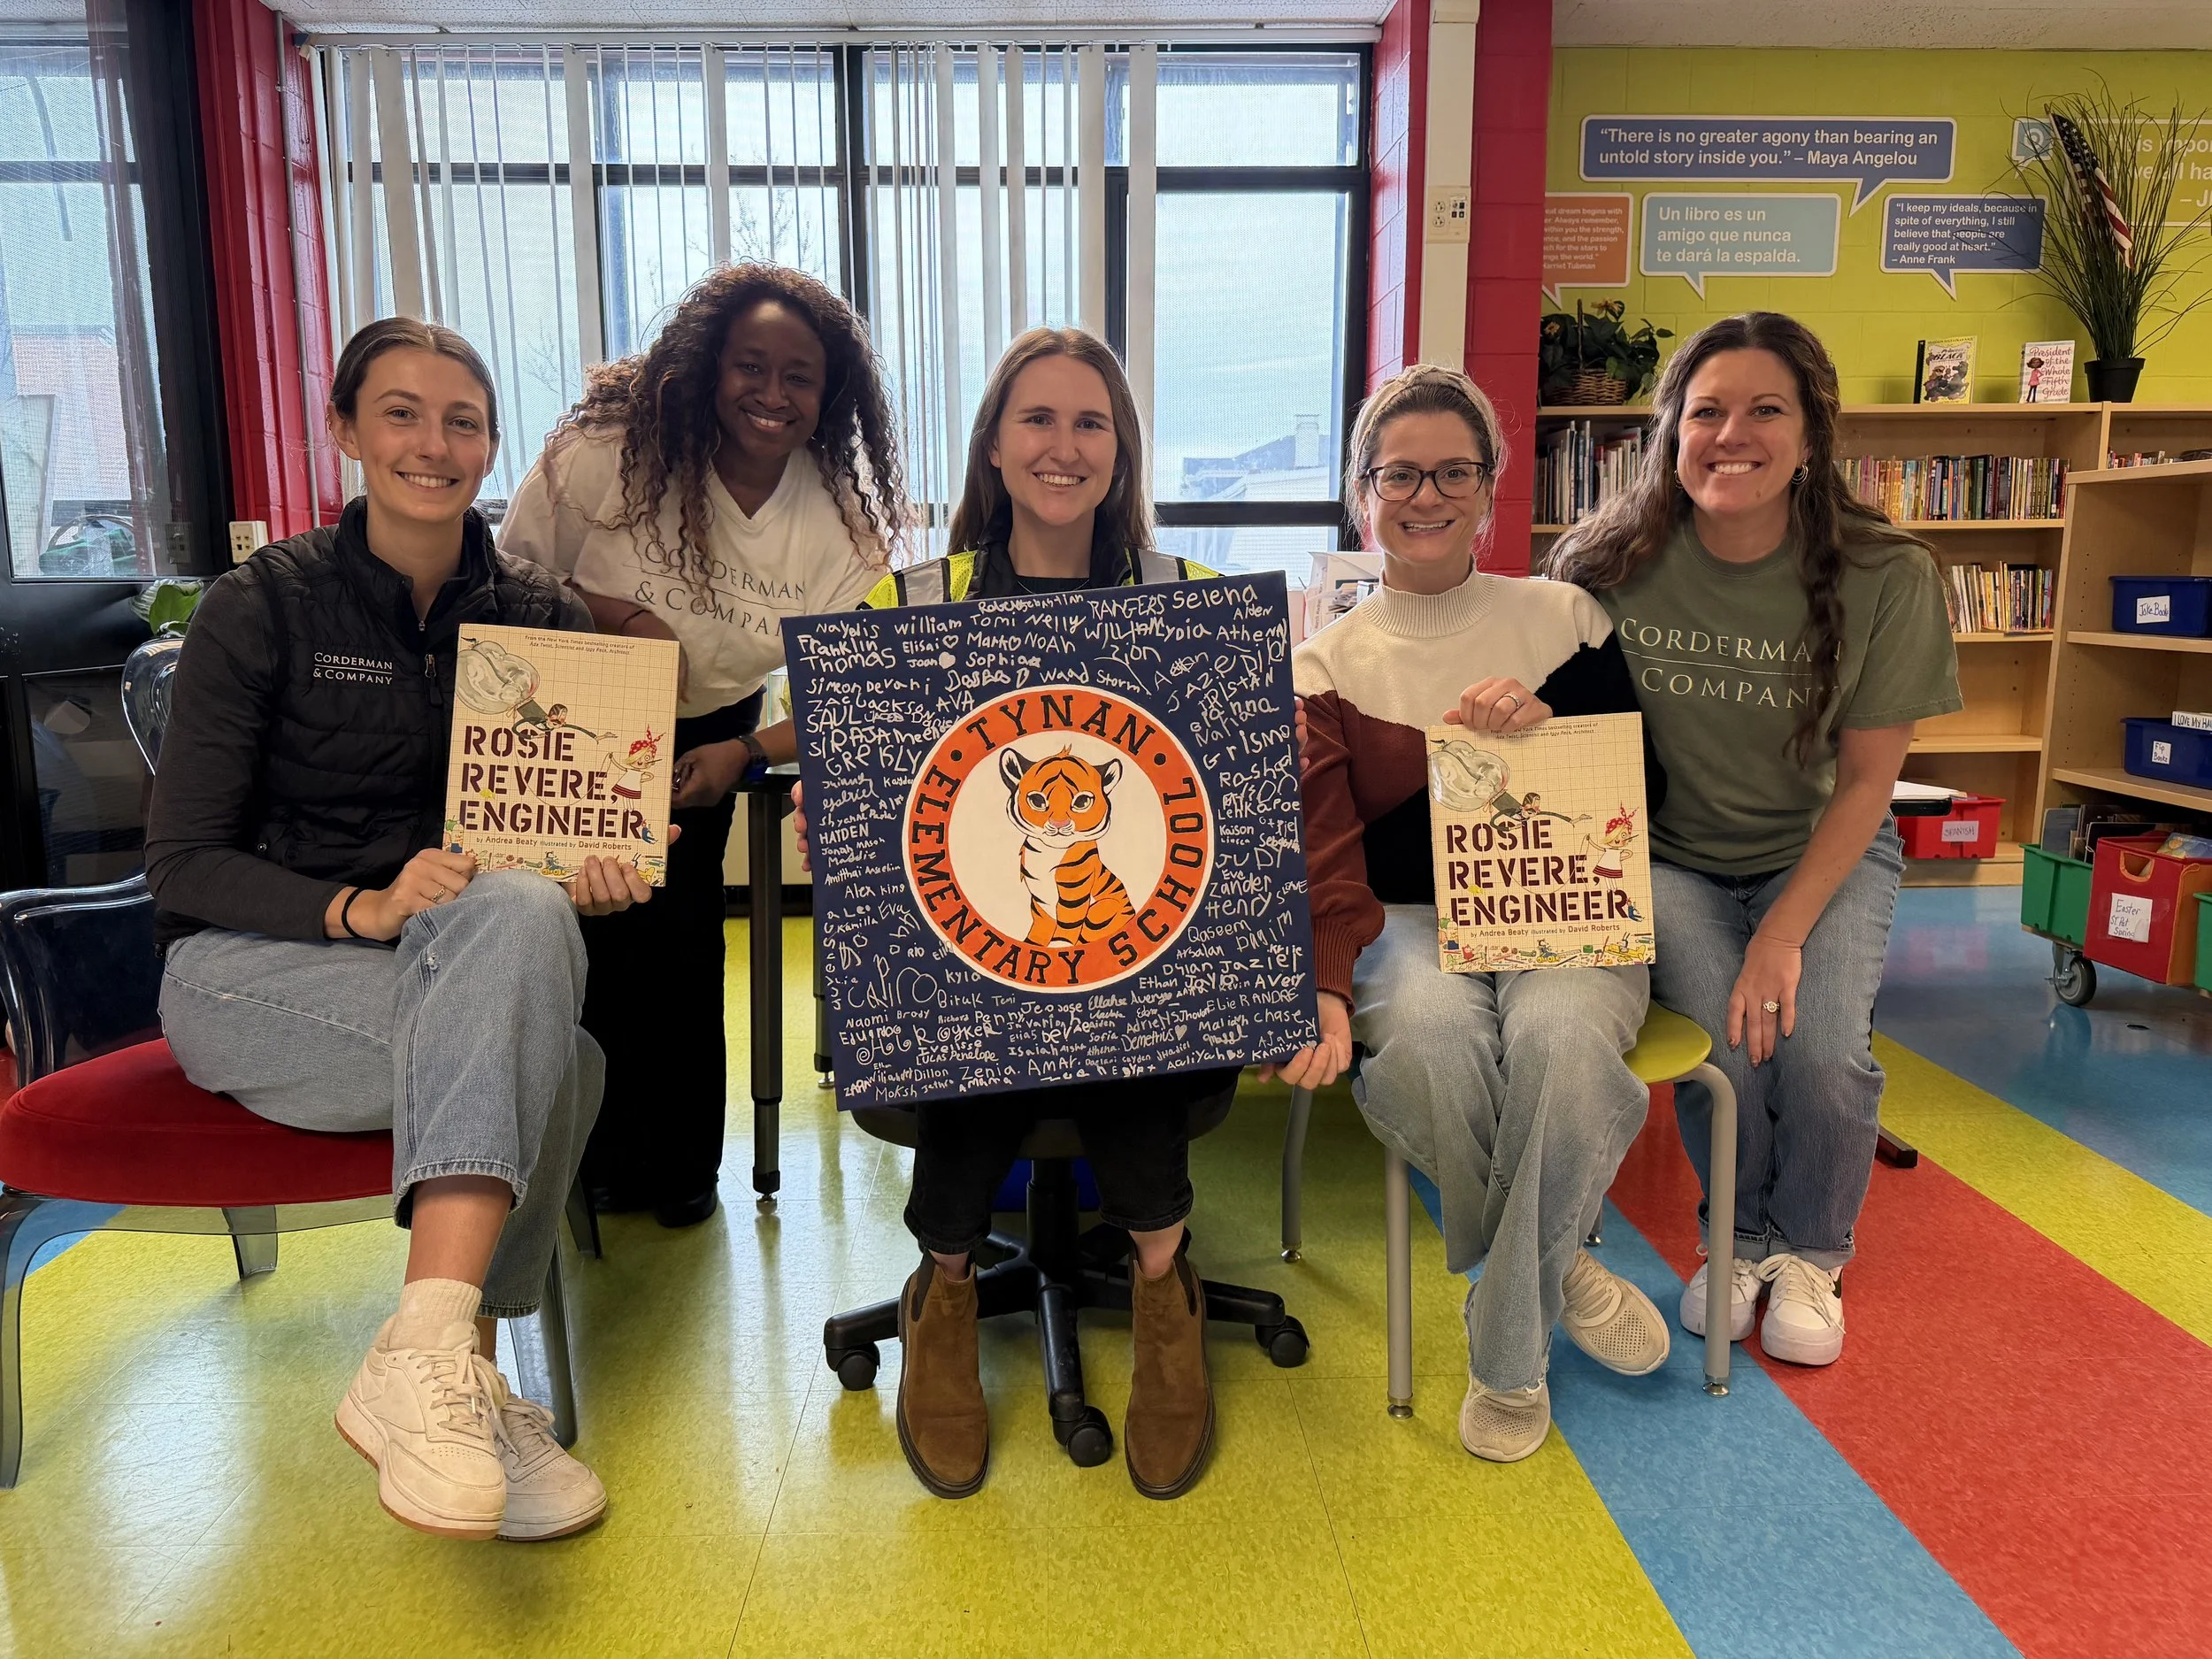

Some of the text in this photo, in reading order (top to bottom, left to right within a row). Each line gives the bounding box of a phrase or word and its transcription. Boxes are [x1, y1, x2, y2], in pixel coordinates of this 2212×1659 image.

[1600, 128, 1938, 149] “There is no greater agony than bearing an
[1599, 150, 1649, 164] untold
[1654, 151, 1694, 168] story
[1698, 150, 1746, 165] inside
[1749, 150, 1791, 167] you.”
[1808, 151, 1847, 168] Maya
[1853, 150, 1917, 168] Angelou
[2190, 162, 2212, 180] ha
[1659, 206, 1765, 221] Un libro es un
[1896, 204, 2037, 214] “I keep my ideals, because in
[1894, 216, 1919, 227] spite
[1921, 216, 1933, 226] of
[1935, 216, 1990, 227] everything,
[1997, 216, 2015, 226] still
[1657, 227, 1791, 244] amigo que nunca
[1893, 228, 1929, 238] believe
[1932, 228, 1950, 238] that
[1656, 248, 1801, 265] te dará la espalda.
[1893, 242, 1995, 253] really good at heart.”
[1899, 255, 1925, 264] Anne
[1927, 254, 1955, 264] Frank
[2030, 345, 2071, 357] President
[2041, 365, 2070, 376] Whole
[2045, 356, 2070, 367] of the
[2042, 375, 2069, 389] Fifth
[2042, 387, 2068, 398] Grade
[634, 580, 781, 637] & COMPA
[1620, 618, 1812, 663] CORDERMA
[314, 652, 393, 670] CORDERMAN
[312, 668, 393, 685] & COMPANY
[1641, 667, 1812, 709] COMPAN
[936, 690, 976, 712] AVA
[807, 704, 862, 733] SAUL
[967, 695, 1156, 755] TYNAN
[2177, 714, 2190, 726] LOVE
[2192, 717, 2201, 728] MY
[464, 725, 575, 762] ROSIE
[461, 763, 618, 803] REVERE,
[459, 800, 643, 840] ENGINEER
[486, 836, 513, 845] Andrea
[516, 837, 538, 847] Beaty
[819, 823, 870, 845] HAYDEN
[1446, 819, 1553, 854] ROSIE
[1215, 847, 1282, 871] JUDY
[911, 764, 1086, 984] ELEMENTARY
[1109, 776, 1204, 969] SCHOOL
[1448, 854, 1600, 890] REVERE,
[1451, 889, 1628, 926] ENGINEER
[2116, 899, 2141, 916] Easter
[1508, 928, 1529, 937] Beaty
[1139, 975, 1178, 990] Ethan
[846, 1010, 888, 1029] Naomi
[914, 1068, 949, 1082] Dillon
